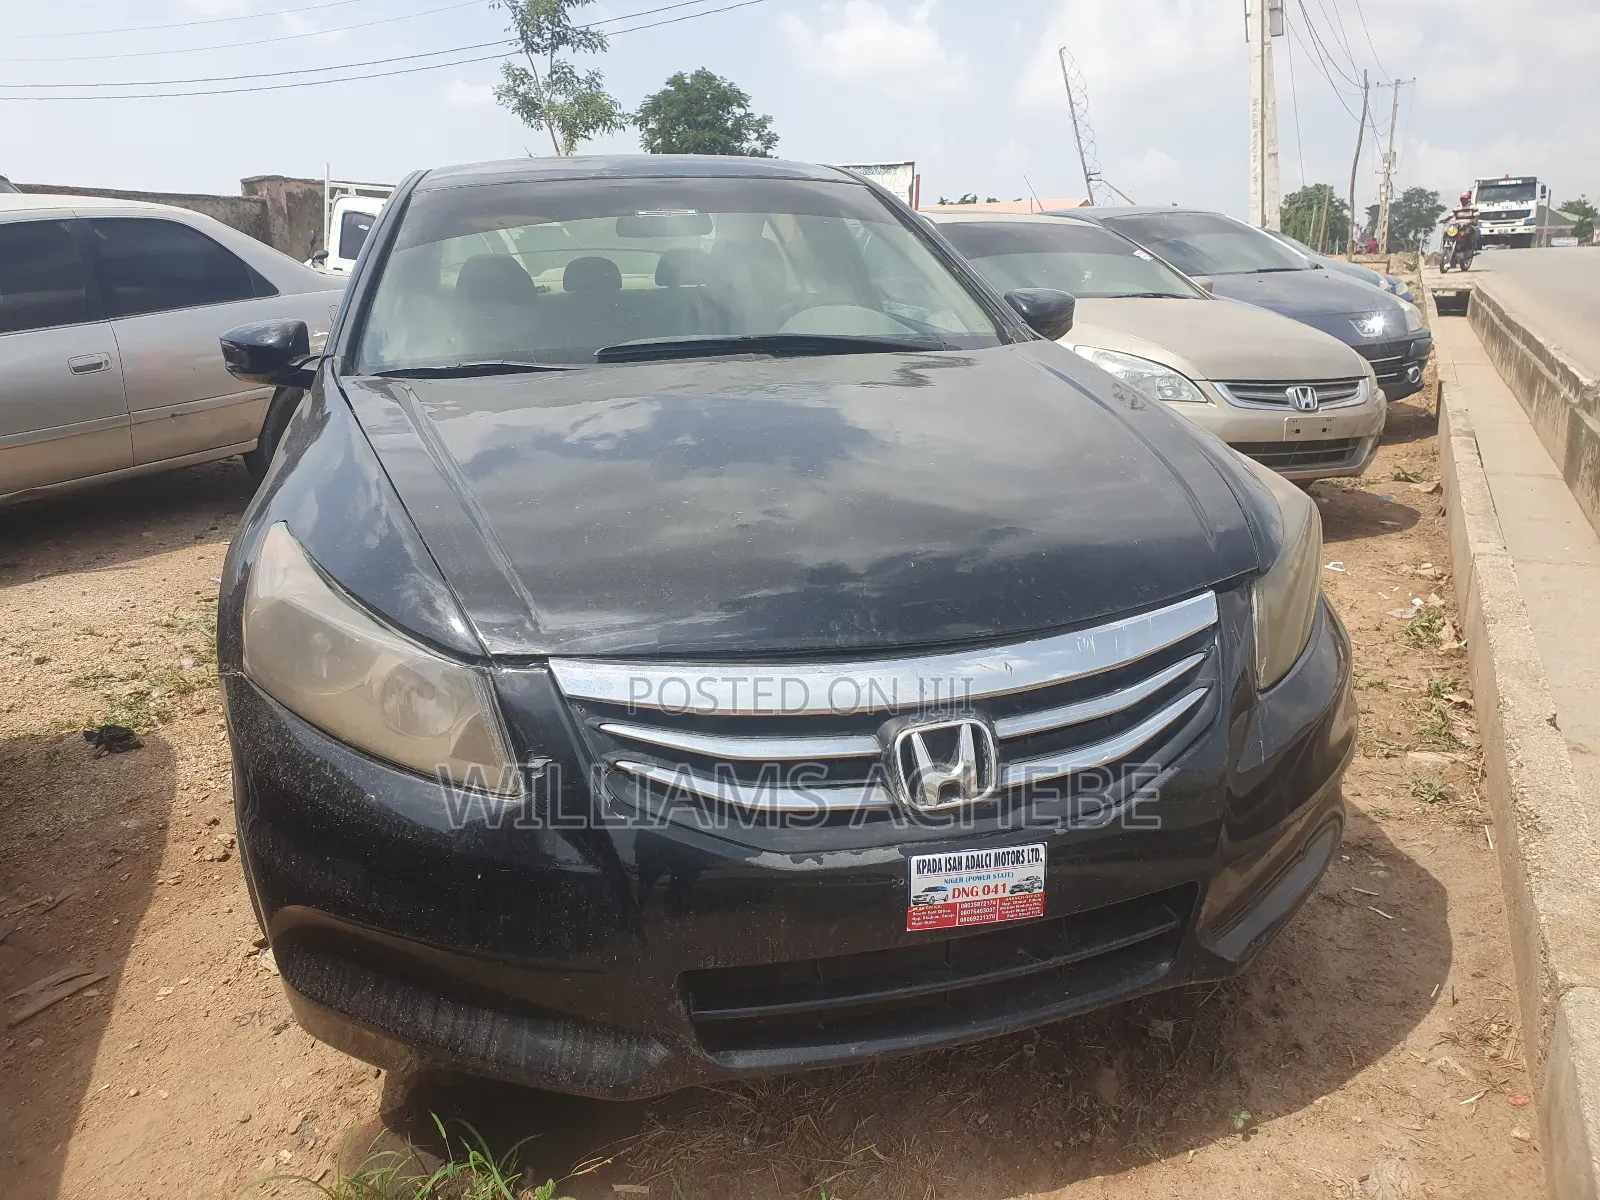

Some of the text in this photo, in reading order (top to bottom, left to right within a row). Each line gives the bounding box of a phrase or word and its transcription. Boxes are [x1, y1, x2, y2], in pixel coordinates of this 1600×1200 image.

[916, 847, 1043, 875] KPADA ISAH ADALCI MOTORS LTD.
[943, 871, 1014, 885] NIGER (POWER STATE)
[951, 882, 1008, 900] DNG 041
